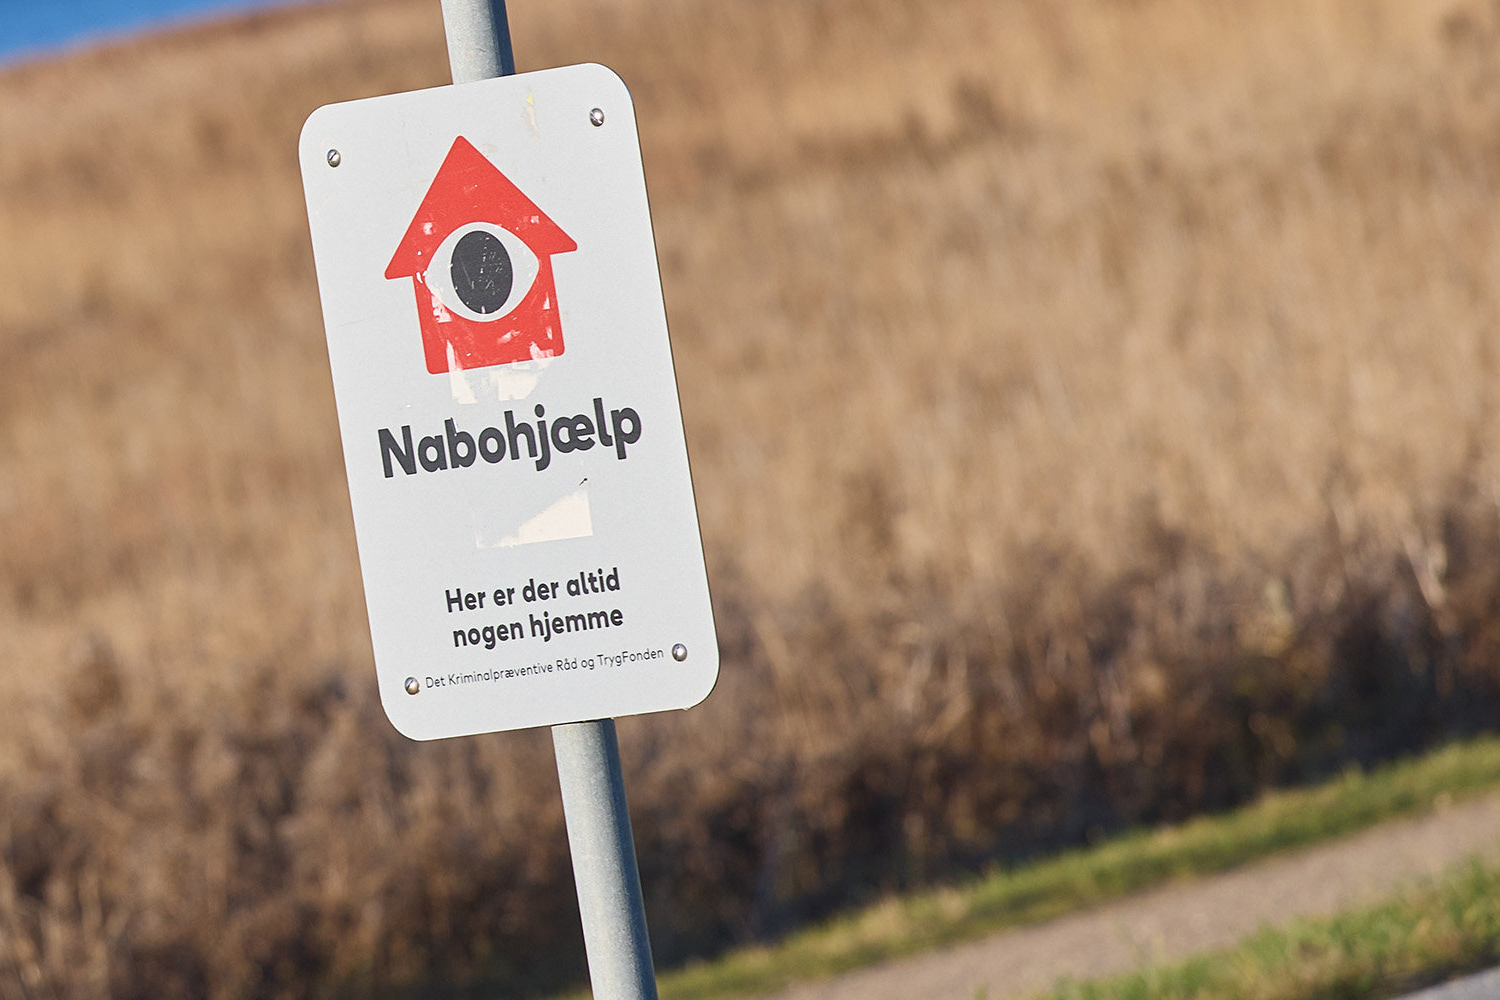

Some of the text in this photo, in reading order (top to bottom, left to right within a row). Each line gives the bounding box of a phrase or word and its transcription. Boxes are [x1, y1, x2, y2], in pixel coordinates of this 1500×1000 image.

[377, 397, 642, 479] Nabohjælp
[445, 567, 621, 613] Her er der altid
[453, 608, 624, 650] nogen hjemme
[425, 648, 665, 690] Det Kriminalpræventive Råd og TrygFonden
